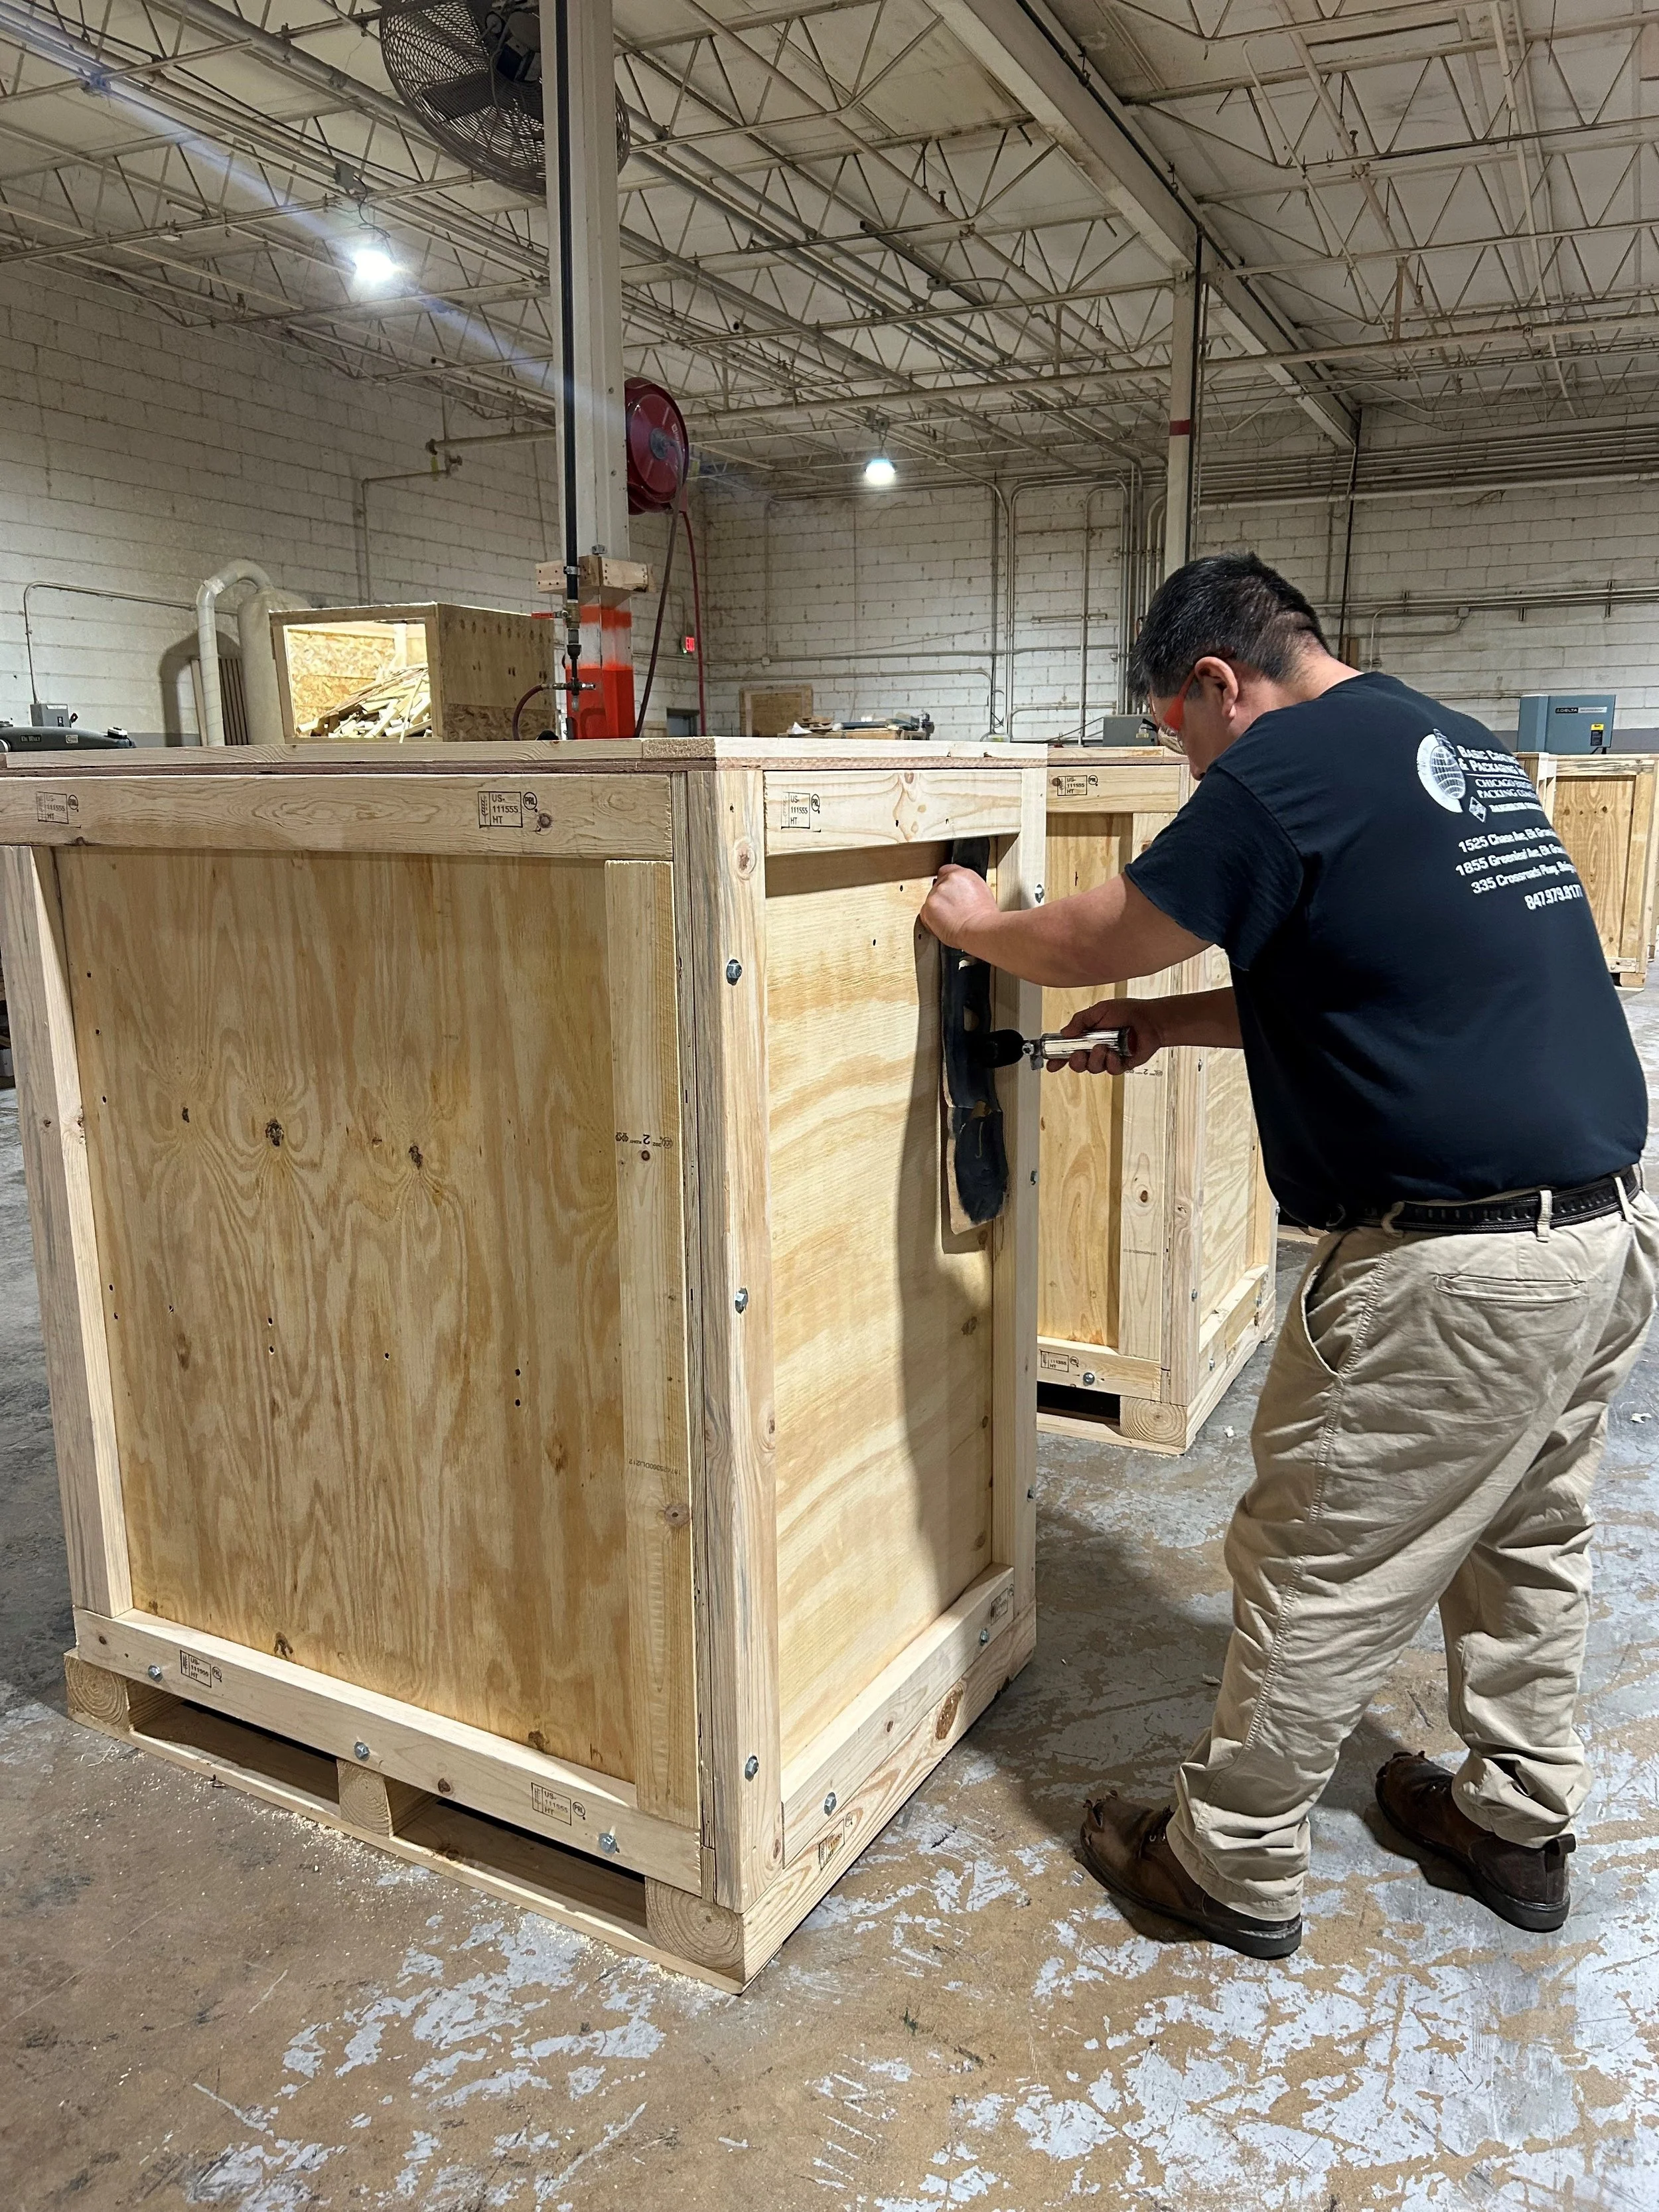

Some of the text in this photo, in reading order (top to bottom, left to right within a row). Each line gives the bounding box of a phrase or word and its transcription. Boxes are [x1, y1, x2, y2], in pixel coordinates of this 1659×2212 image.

[1457, 758, 1470, 771] &
[1475, 779, 1516, 788] CHICAGO
[1476, 789, 1518, 799] PACKING
[492, 805, 519, 814] 111555
[492, 816, 503, 824] HT
[790, 817, 798, 826] HT
[1458, 836, 1489, 853] 1525
[1455, 857, 1489, 877] 1855
[1471, 877, 1497, 894] 335
[643, 1134, 650, 1145] 2
[544, 1791, 556, 1799] US-
[545, 1799, 568, 1813] 111555
[545, 1806, 555, 1815] HT
